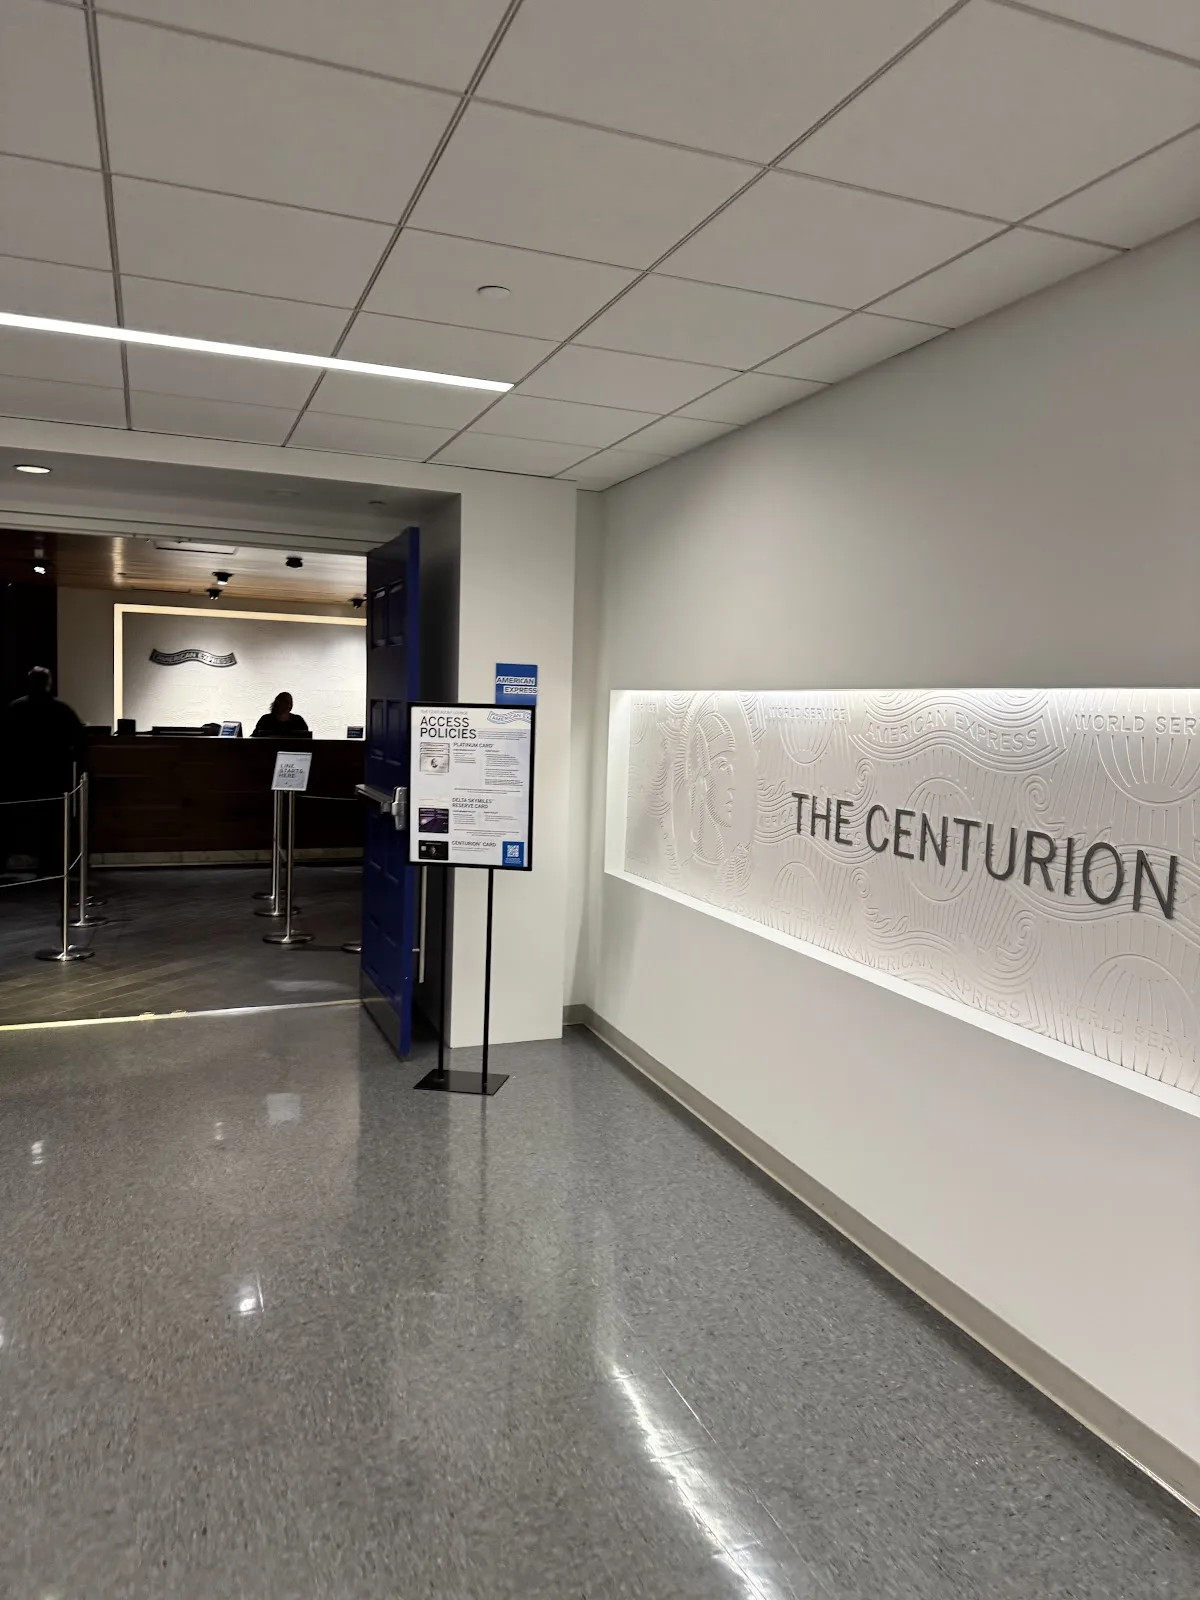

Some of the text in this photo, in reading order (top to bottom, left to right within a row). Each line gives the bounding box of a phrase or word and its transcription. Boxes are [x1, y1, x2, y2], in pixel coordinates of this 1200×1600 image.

[496, 676, 535, 685] AMERICAN
[504, 686, 537, 694] EXPRESS
[803, 707, 846, 721] SERVICE
[420, 716, 470, 728] ACCESS
[1074, 713, 1146, 733] WORLD
[420, 727, 478, 739] POLICIES
[866, 709, 1038, 752] AMERICAN EXPRESS
[791, 792, 854, 846] THE
[866, 804, 1178, 920] CENTURION
